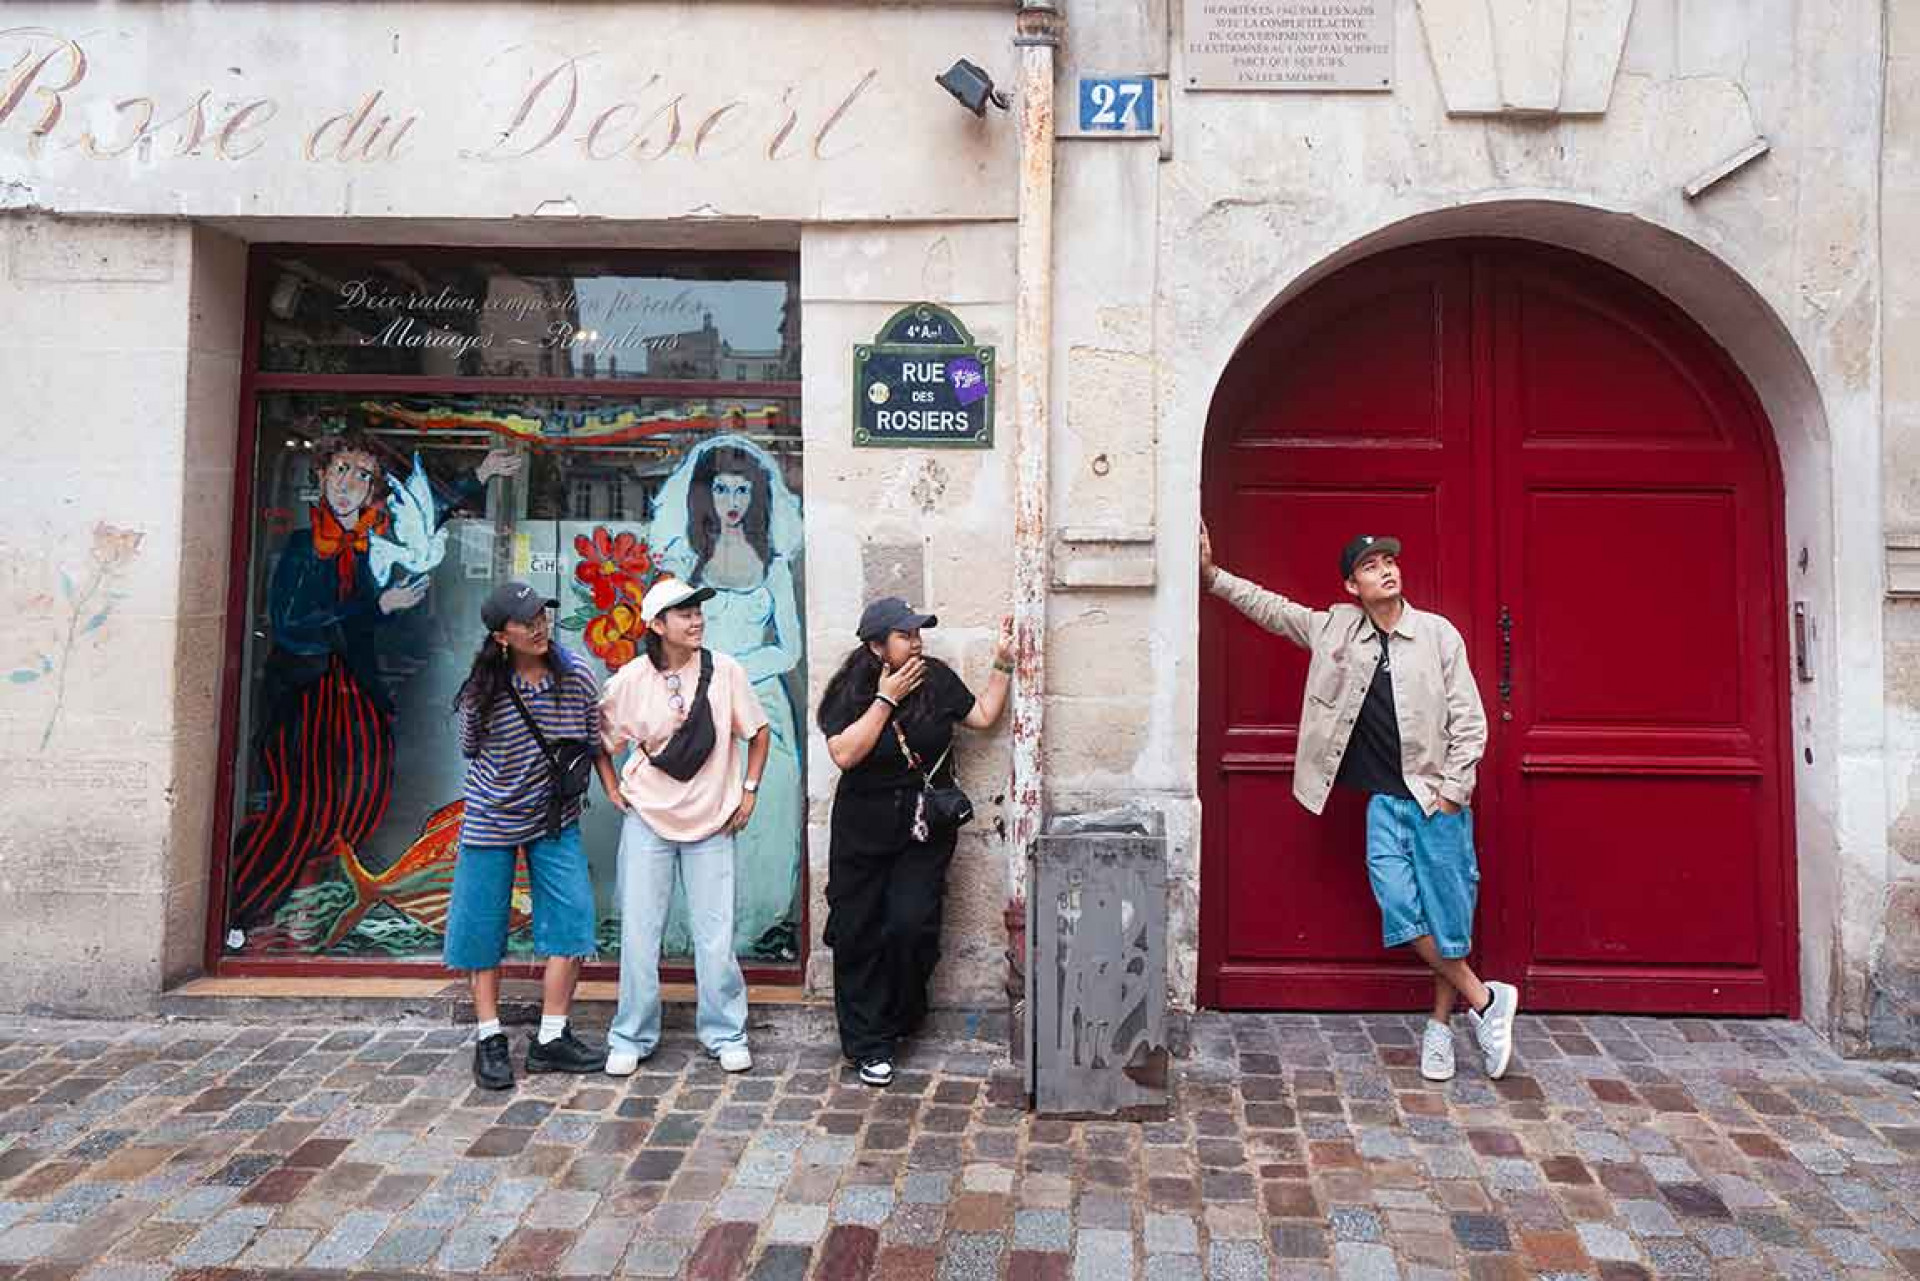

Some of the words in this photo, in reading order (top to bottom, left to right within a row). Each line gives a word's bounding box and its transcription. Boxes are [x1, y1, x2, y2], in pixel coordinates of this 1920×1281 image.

[1091, 84, 1142, 123] 27
[302, 90, 417, 161] du
[902, 363, 945, 383] RUE
[912, 391, 935, 402] DES
[877, 410, 969, 431] ROSIERS
